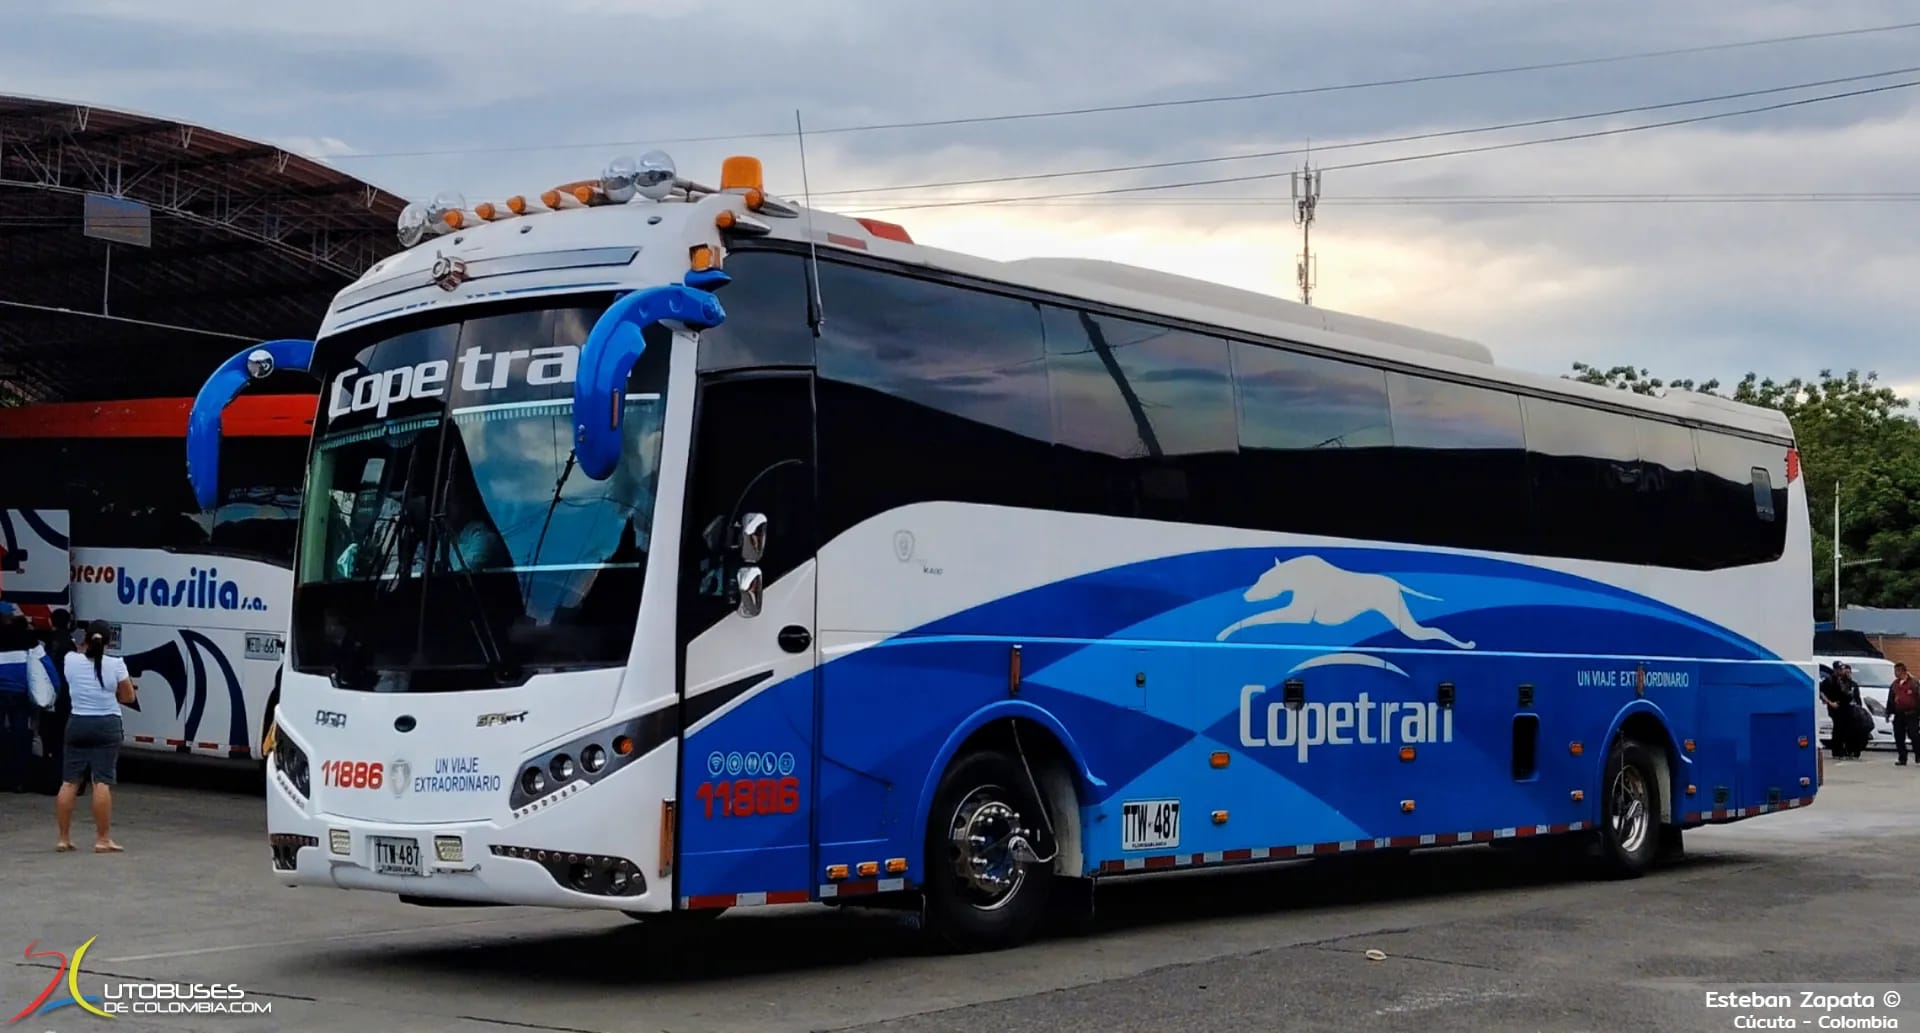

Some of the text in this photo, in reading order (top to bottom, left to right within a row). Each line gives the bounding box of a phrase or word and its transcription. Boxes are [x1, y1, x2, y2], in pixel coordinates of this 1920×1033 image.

[328, 344, 632, 419] Copetra
[70, 564, 115, 584] preso
[117, 566, 238, 610] brasilia
[1577, 670, 1591, 687] UN
[1592, 670, 1617, 687] VIAJE
[1240, 684, 1452, 763] Copetran
[320, 760, 384, 790] 11886
[435, 757, 479, 774] UN VIAJE
[414, 775, 501, 793] EXTRAORDINARIO
